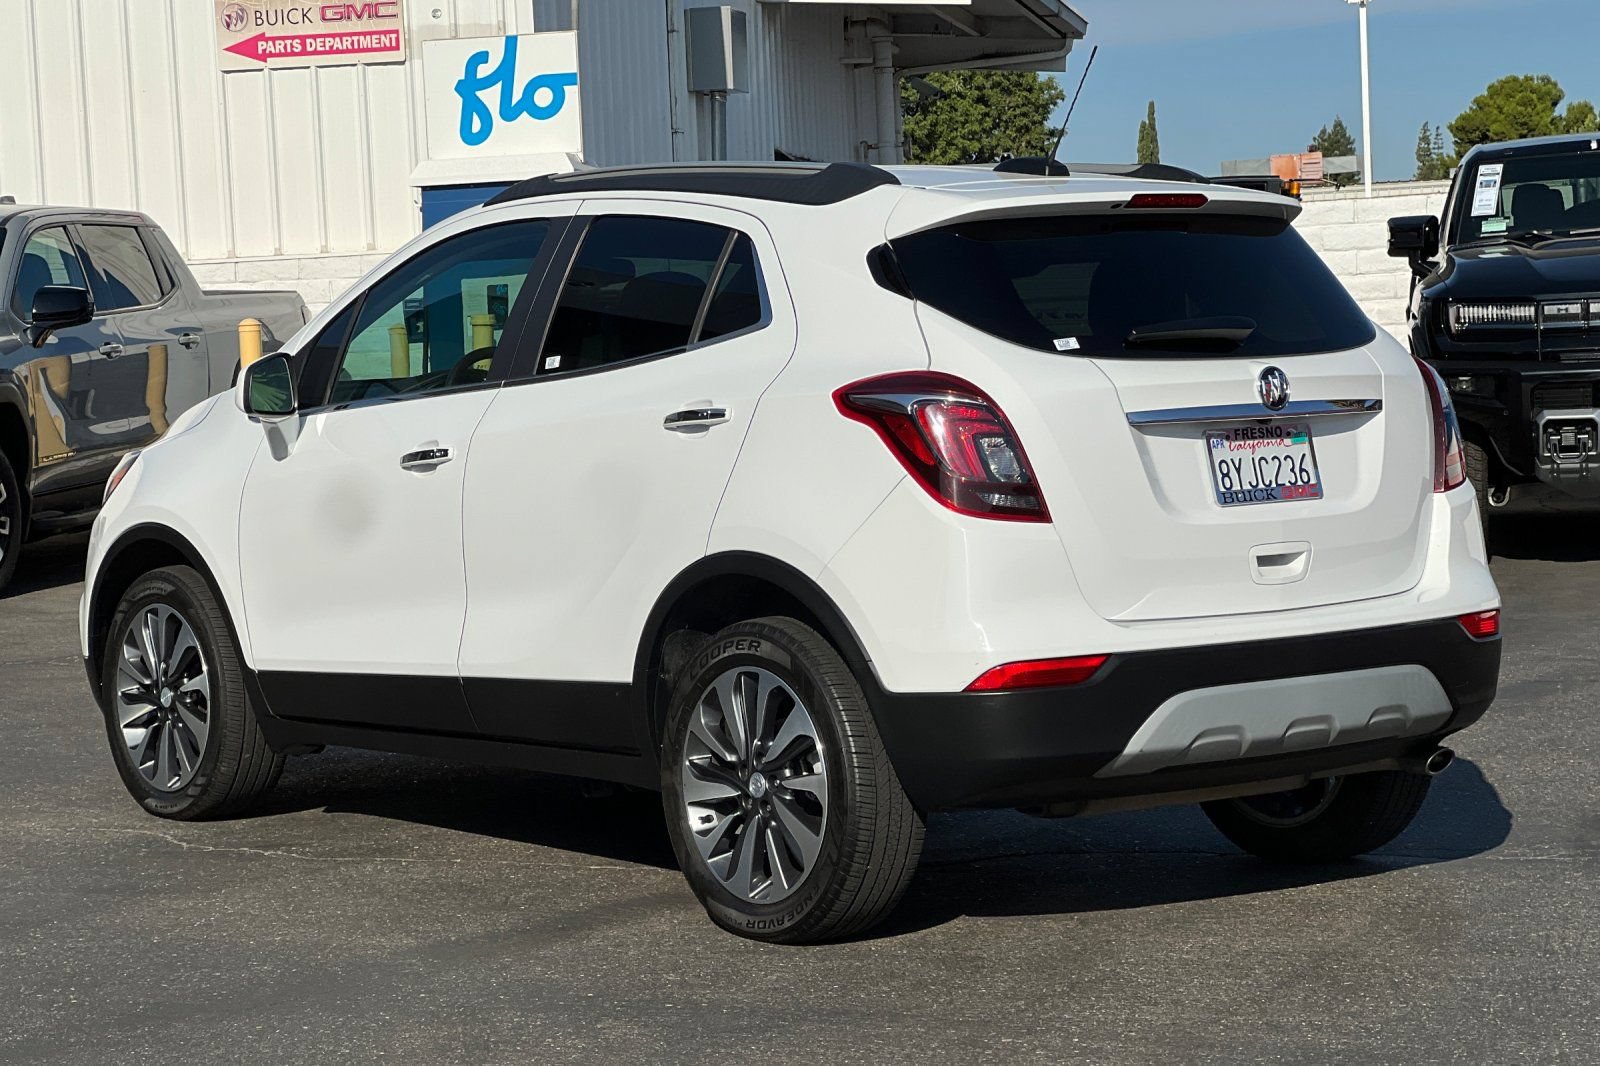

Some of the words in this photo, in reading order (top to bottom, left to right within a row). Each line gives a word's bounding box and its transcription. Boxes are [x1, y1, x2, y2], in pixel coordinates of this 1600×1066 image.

[254, 7, 314, 27] BUICK
[319, 0, 399, 22] GMC
[257, 36, 302, 55] PARTS
[305, 33, 398, 52] DEPARTMENT
[454, 35, 577, 146] flo
[1234, 427, 1282, 440] FRESNO
[1212, 440, 1225, 449] APR
[1218, 453, 1311, 491] 8YJC236
[1222, 489, 1278, 503] BUICK
[1281, 484, 1320, 499] GMC
